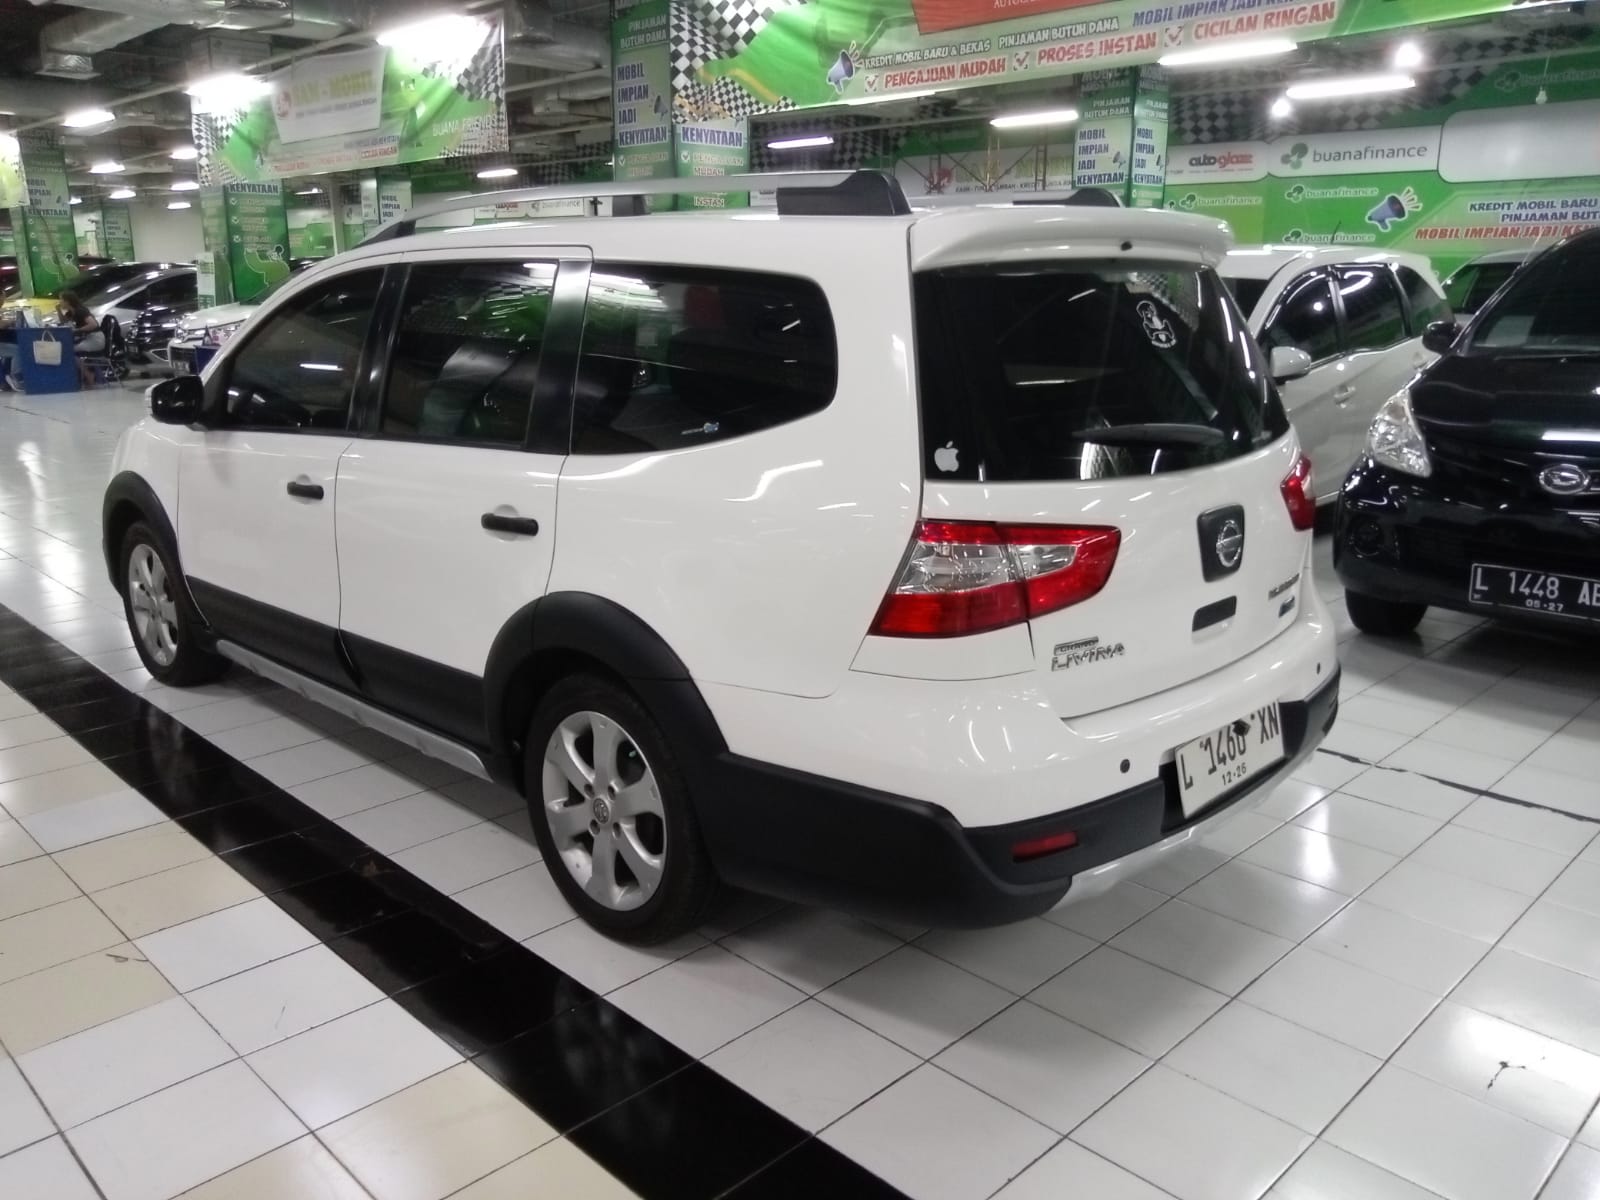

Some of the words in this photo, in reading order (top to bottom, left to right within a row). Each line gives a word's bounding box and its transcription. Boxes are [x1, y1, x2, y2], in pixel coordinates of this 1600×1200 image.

[1194, 14, 1259, 40] CICILAN
[1263, 1, 1336, 30] RINGAN
[864, 55, 893, 69] KREDIT
[895, 51, 922, 65] MOBIL
[923, 46, 949, 60] BARU
[950, 45, 958, 56] &
[960, 40, 991, 55] BEKAS
[999, 28, 1050, 49] PINJAMAN
[1051, 22, 1087, 40] BUTUH
[1088, 16, 1119, 33] DANA
[1132, 6, 1173, 27] MOBIL
[1177, 0, 1228, 19] IMPIAN
[1038, 41, 1094, 65] PROSES
[1098, 32, 1157, 56] INSTAN
[617, 63, 645, 81] MOBIL
[885, 64, 956, 88] PENGAJUAN
[959, 57, 1006, 78] MUDAH
[618, 84, 649, 103] IMPIAN
[618, 108, 637, 124] JADI
[618, 127, 667, 146] KENYATAAN
[681, 126, 743, 147] KENYATAAN
[1079, 128, 1106, 140] MOBIL
[1137, 128, 1153, 140] MOBIL
[1078, 143, 1109, 156] IMPIAN
[1136, 143, 1155, 155] IMPIAN
[1312, 144, 1428, 163] buanafinance
[1077, 159, 1096, 171] JADI
[1134, 158, 1147, 169] JADI
[1076, 172, 1124, 185] KENYATAAN
[1134, 173, 1163, 185] KENYATAAN
[229, 183, 279, 194] KENYATAAN
[1305, 186, 1378, 198] buanafinance
[1198, 195, 1263, 206] buanafinance
[1469, 202, 1514, 212] KREDIT
[1517, 200, 1557, 211] MOBIL
[1561, 198, 1598, 208] BARU
[1501, 212, 1568, 222] PINJAMAN
[1303, 232, 1375, 243] buanafinance
[1415, 228, 1460, 239] MOBIL
[1464, 226, 1521, 238] IMPIAN
[1522, 225, 1558, 238] JADI
[1475, 567, 1489, 590] L
[1509, 571, 1560, 599] 1448
[1181, 753, 1194, 791] L
[1257, 702, 1279, 744] XN
